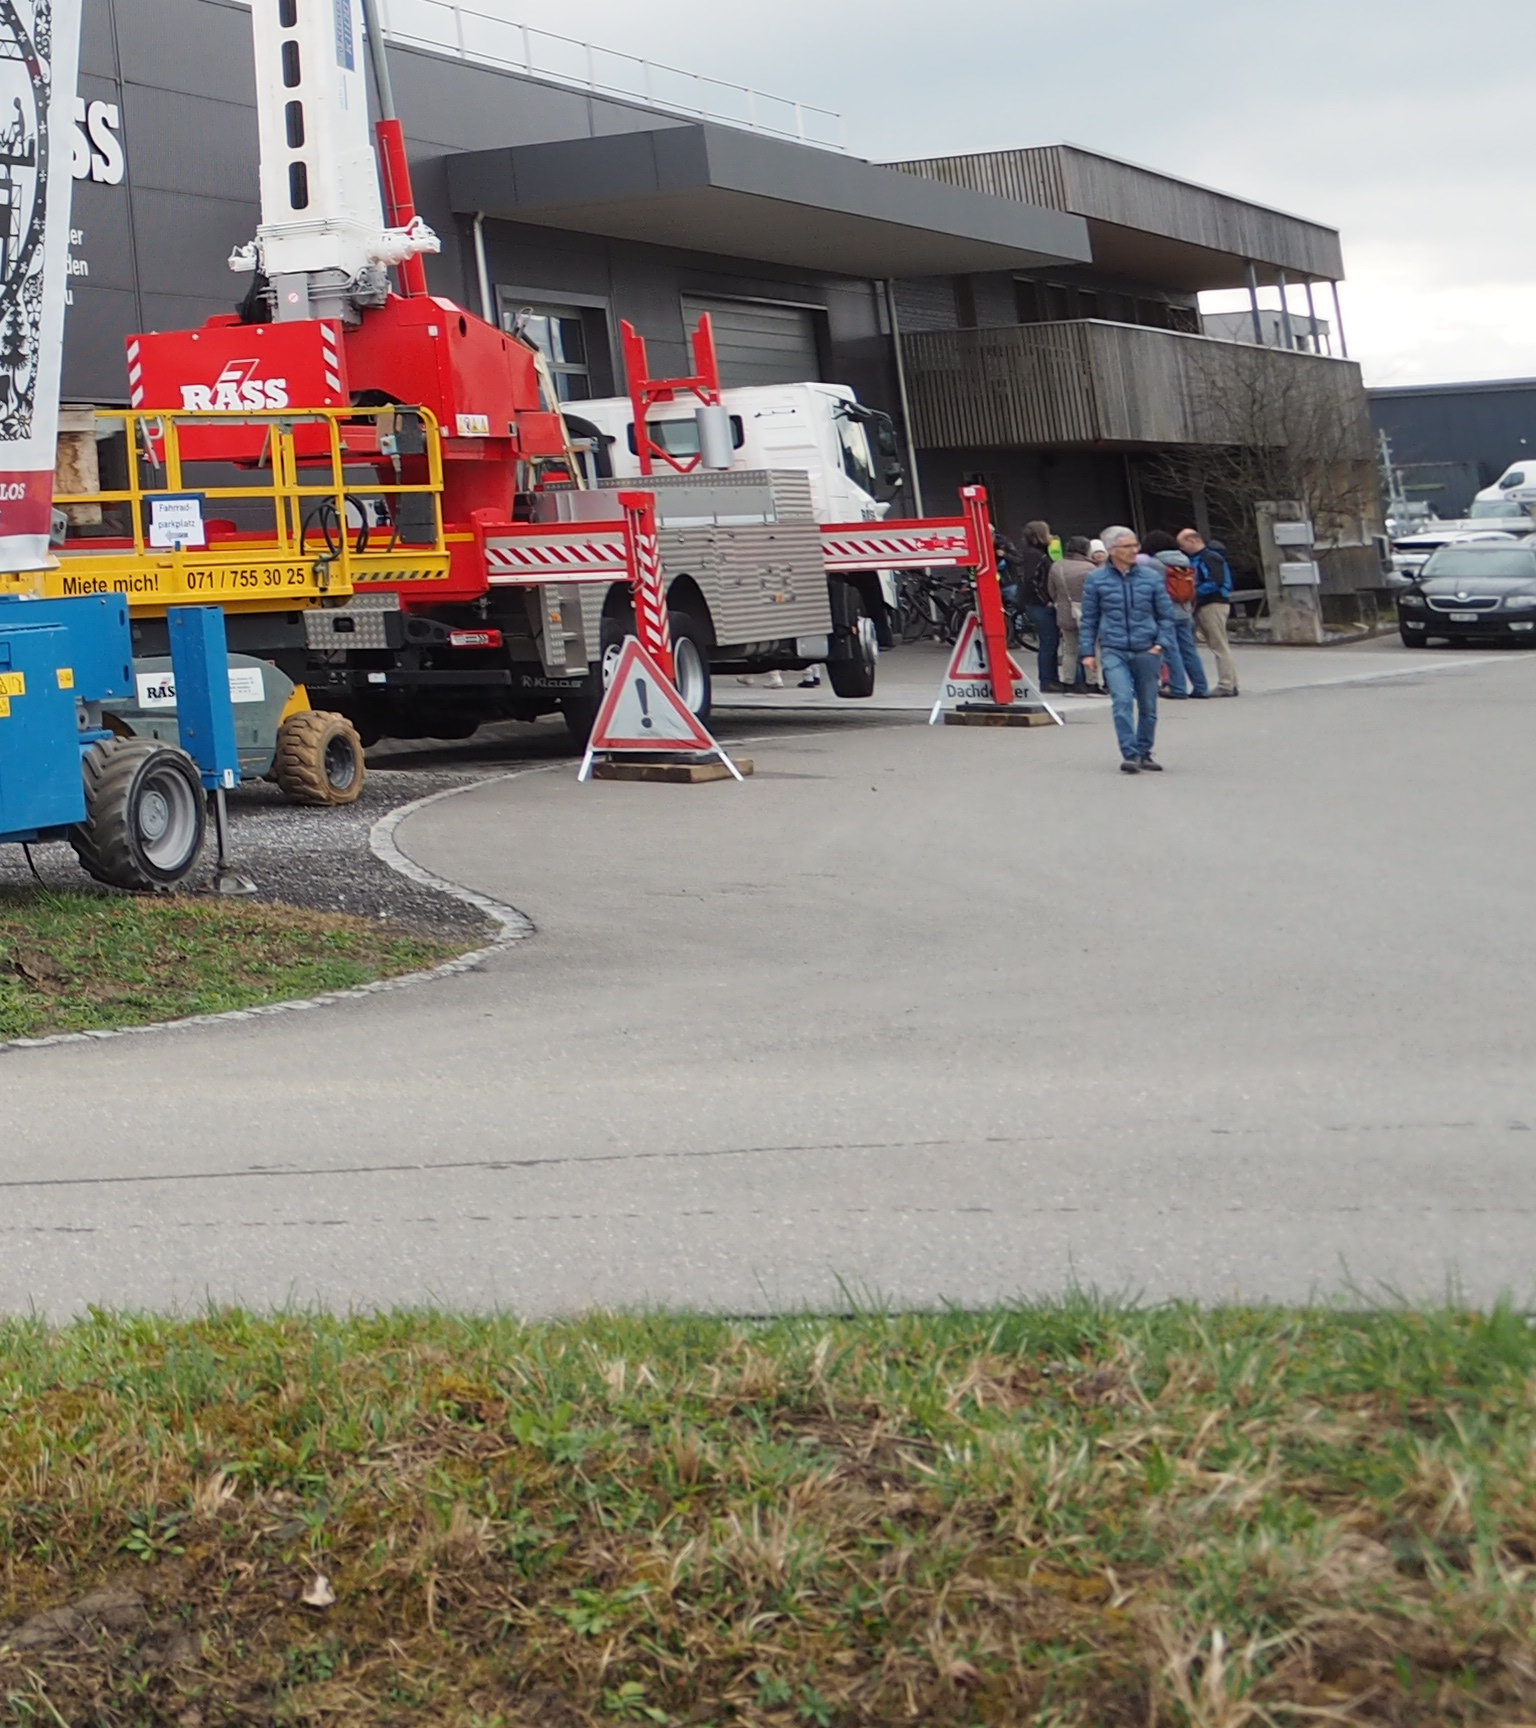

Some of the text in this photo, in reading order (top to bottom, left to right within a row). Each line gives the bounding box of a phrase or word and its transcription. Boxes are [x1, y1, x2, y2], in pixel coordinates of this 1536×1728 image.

[158, 503, 193, 513] Fahrrad-
[157, 518, 196, 529] parkplatz
[62, 576, 108, 595] Miete
[114, 574, 159, 592] mich!
[187, 571, 214, 589] 071
[230, 570, 259, 588] 755
[263, 569, 282, 586] 30
[286, 568, 305, 585] 25
[946, 683, 1030, 699] Dachder
